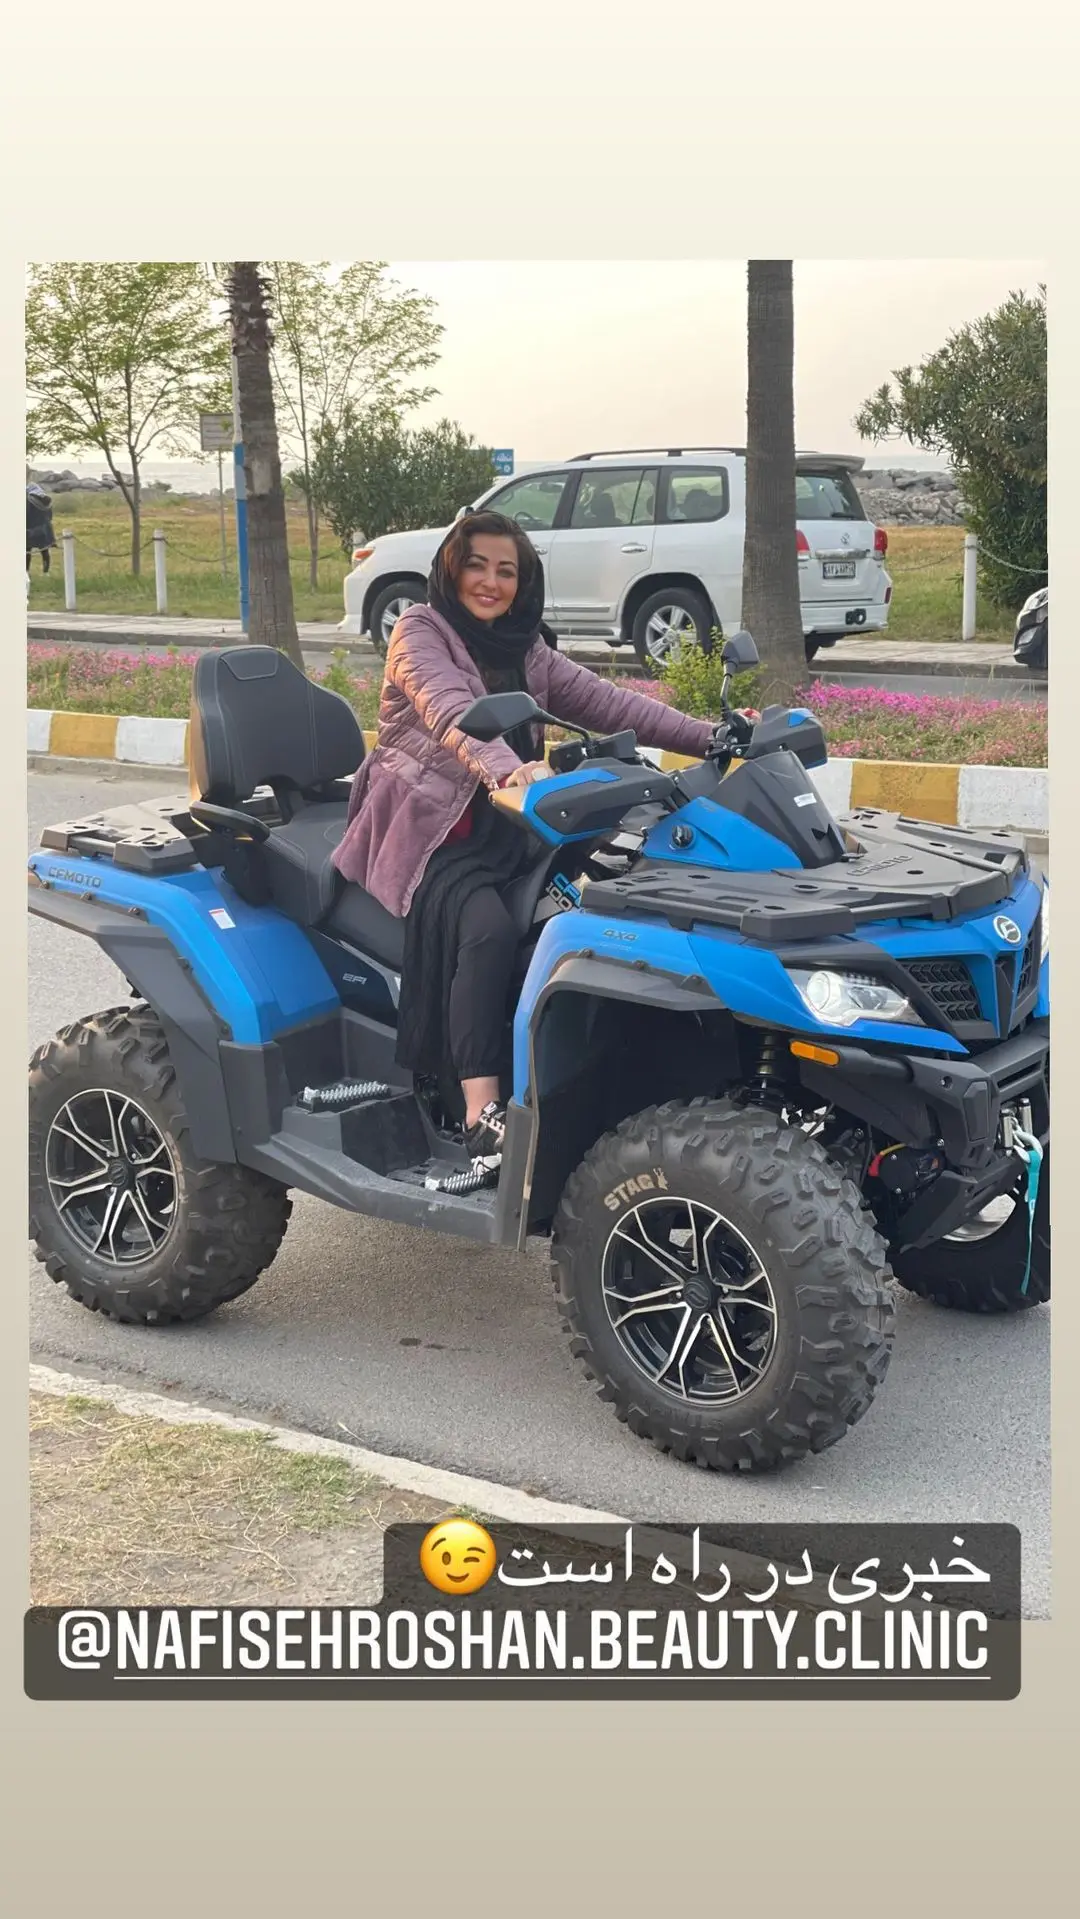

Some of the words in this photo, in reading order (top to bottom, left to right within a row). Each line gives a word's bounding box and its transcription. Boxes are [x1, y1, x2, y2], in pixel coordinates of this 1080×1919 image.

[48, 867, 101, 888] CFMOTO
[342, 973, 368, 985] EFI
[603, 1173, 656, 1212] STAG
